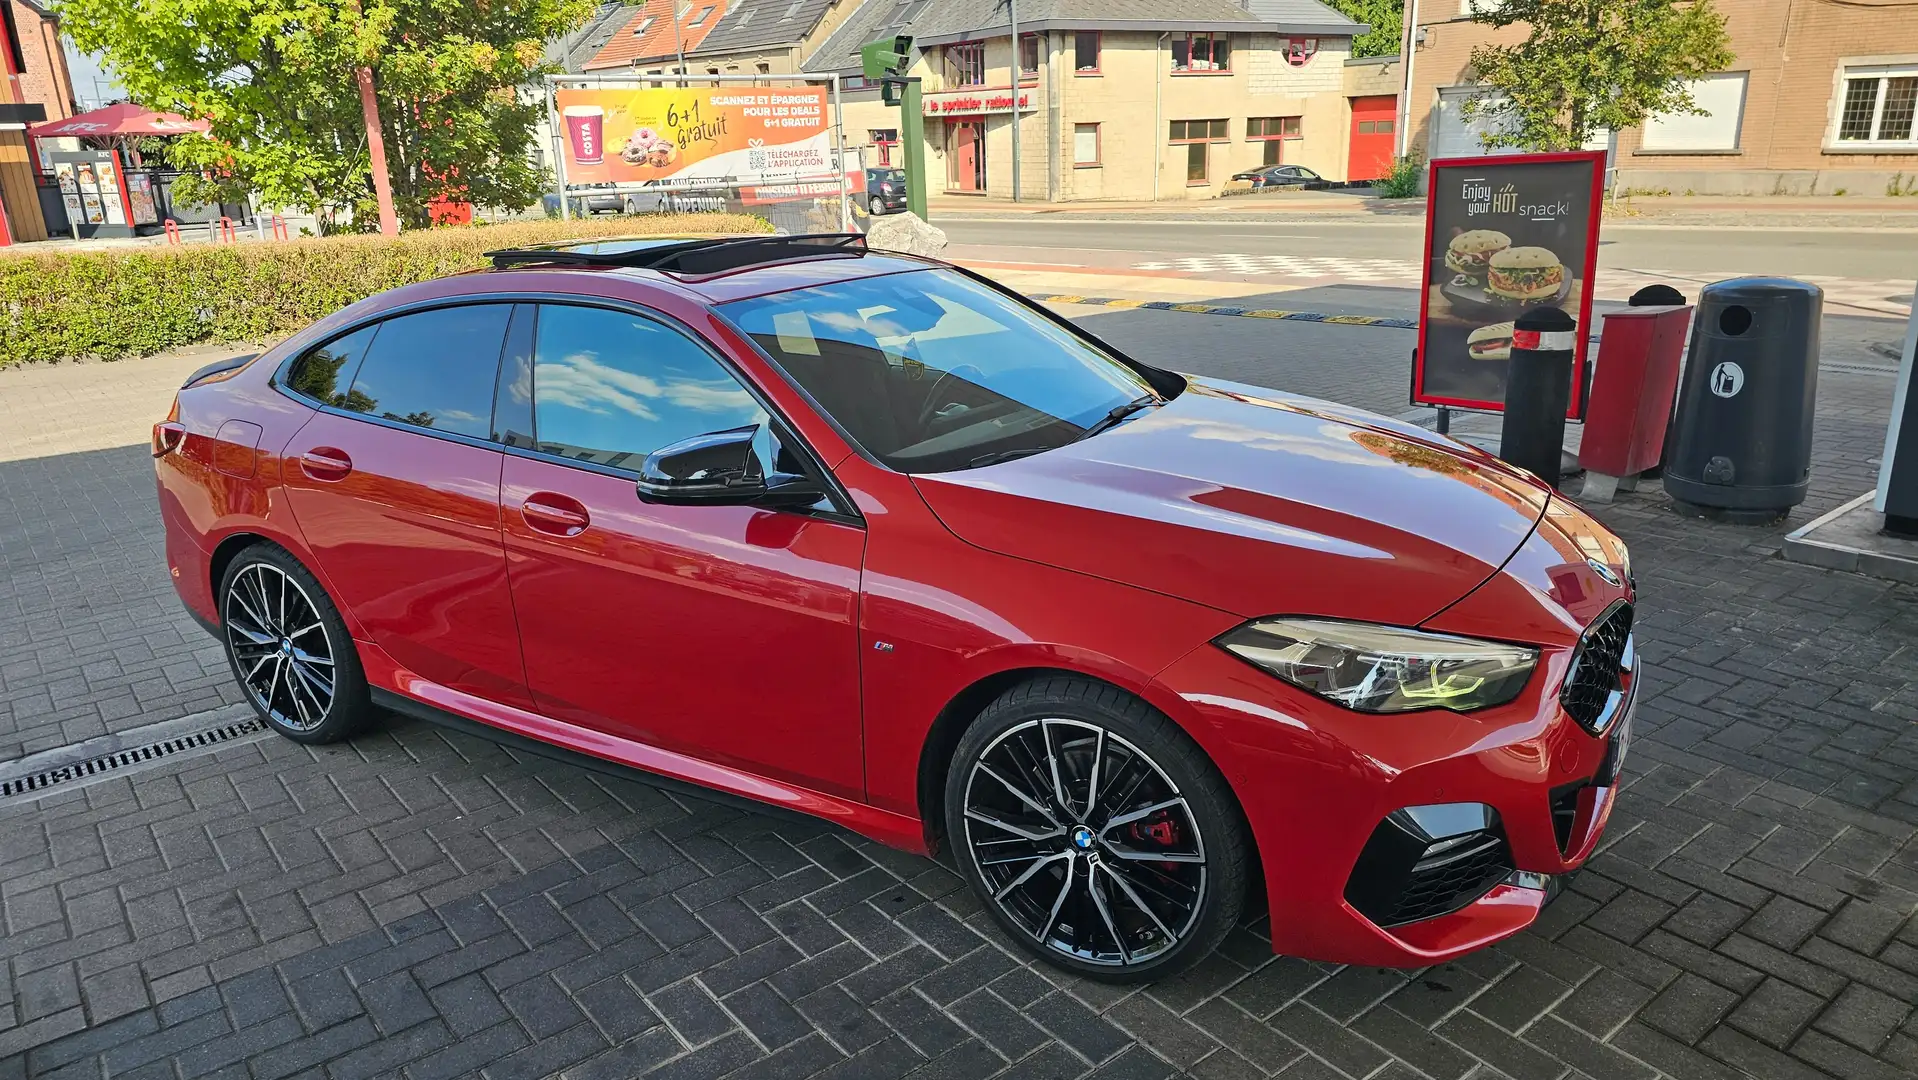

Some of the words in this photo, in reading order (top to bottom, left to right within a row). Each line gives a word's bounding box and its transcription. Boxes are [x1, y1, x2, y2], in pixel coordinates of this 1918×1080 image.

[710, 95, 756, 105] SCANNEZ
[757, 95, 769, 105] ET
[771, 93, 819, 105] ÉPARGNEZ
[667, 99, 700, 127] 6+1
[743, 107, 771, 116] POUR
[772, 107, 789, 116] LES
[791, 106, 820, 116] DEALS
[764, 118, 780, 128] 6+1
[781, 117, 820, 127] GRATUIT
[581, 122, 593, 155] COSTA
[677, 115, 728, 150] gratuit
[767, 149, 819, 159] TÉLÉCHARGEZ
[768, 158, 824, 168] L'APPLICATION
[1462, 183, 1491, 202] Enjoy
[674, 197, 726, 213] OPENING
[1468, 202, 1491, 217] your
[1492, 193, 1518, 213] HOT
[1519, 200, 1570, 216] snack!
